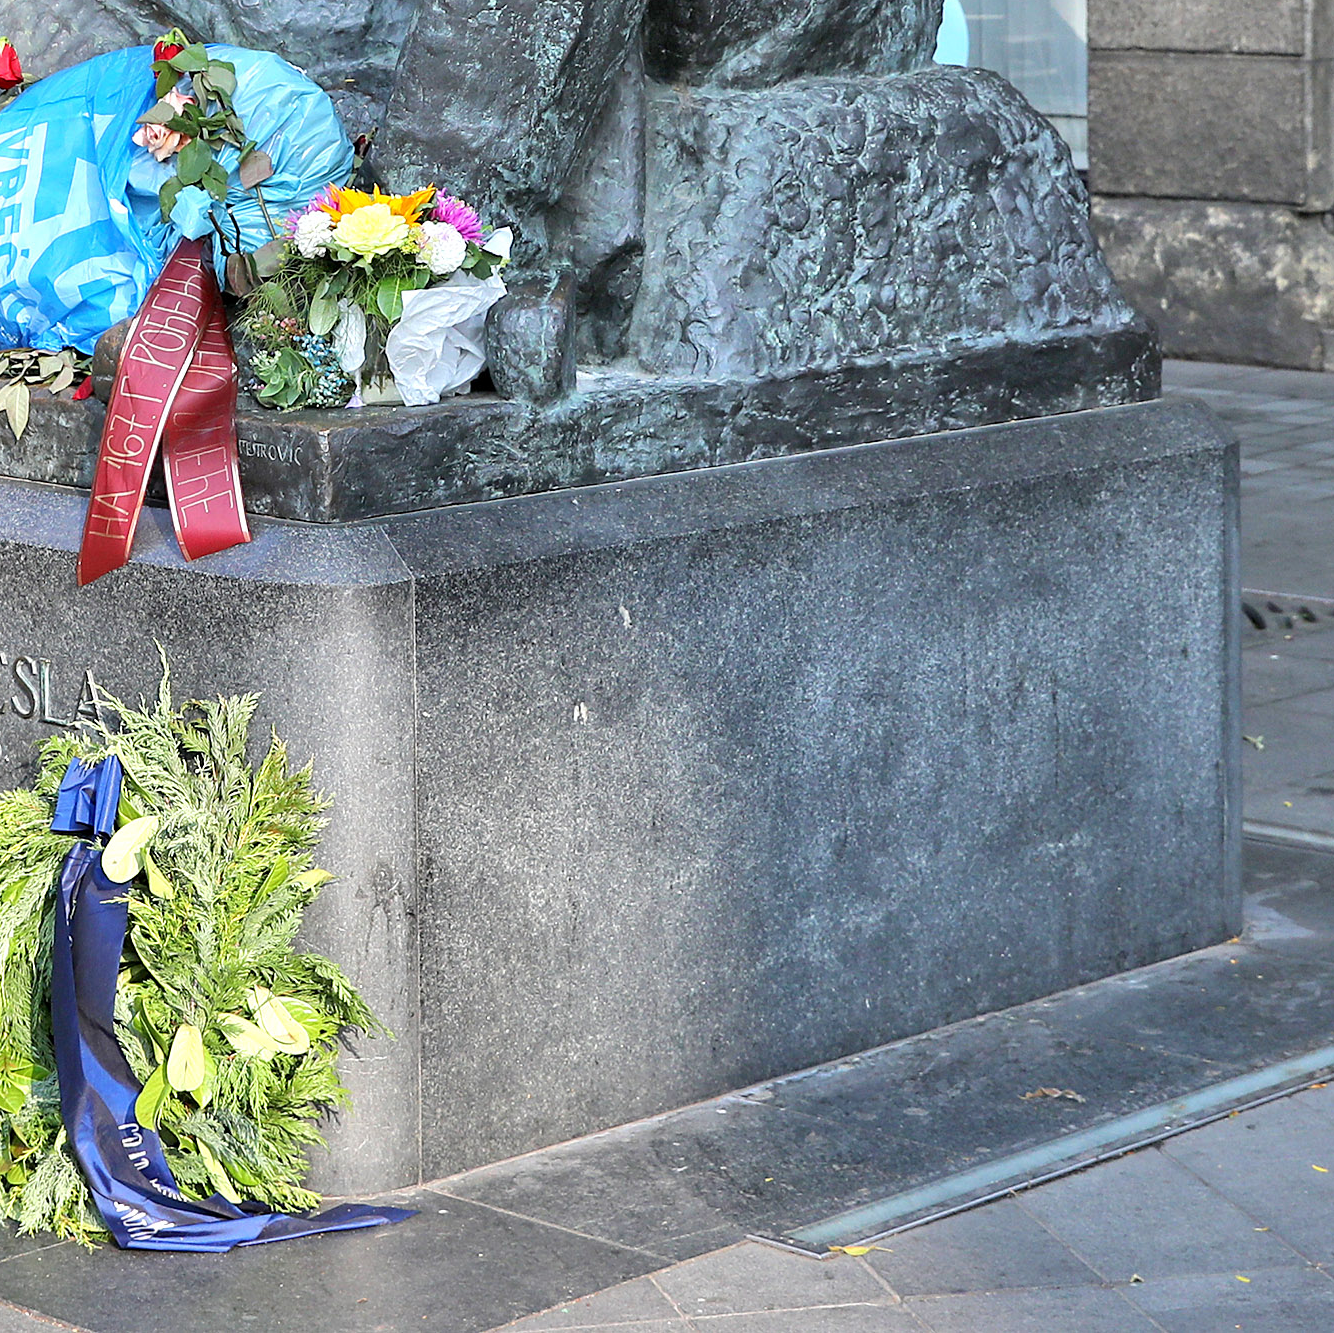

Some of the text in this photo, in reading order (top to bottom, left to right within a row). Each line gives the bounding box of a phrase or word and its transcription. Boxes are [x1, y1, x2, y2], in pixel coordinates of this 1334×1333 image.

[129, 256, 203, 371] РОЂЕЊА
[102, 412, 154, 470] 167.
[88, 488, 136, 540] НА
